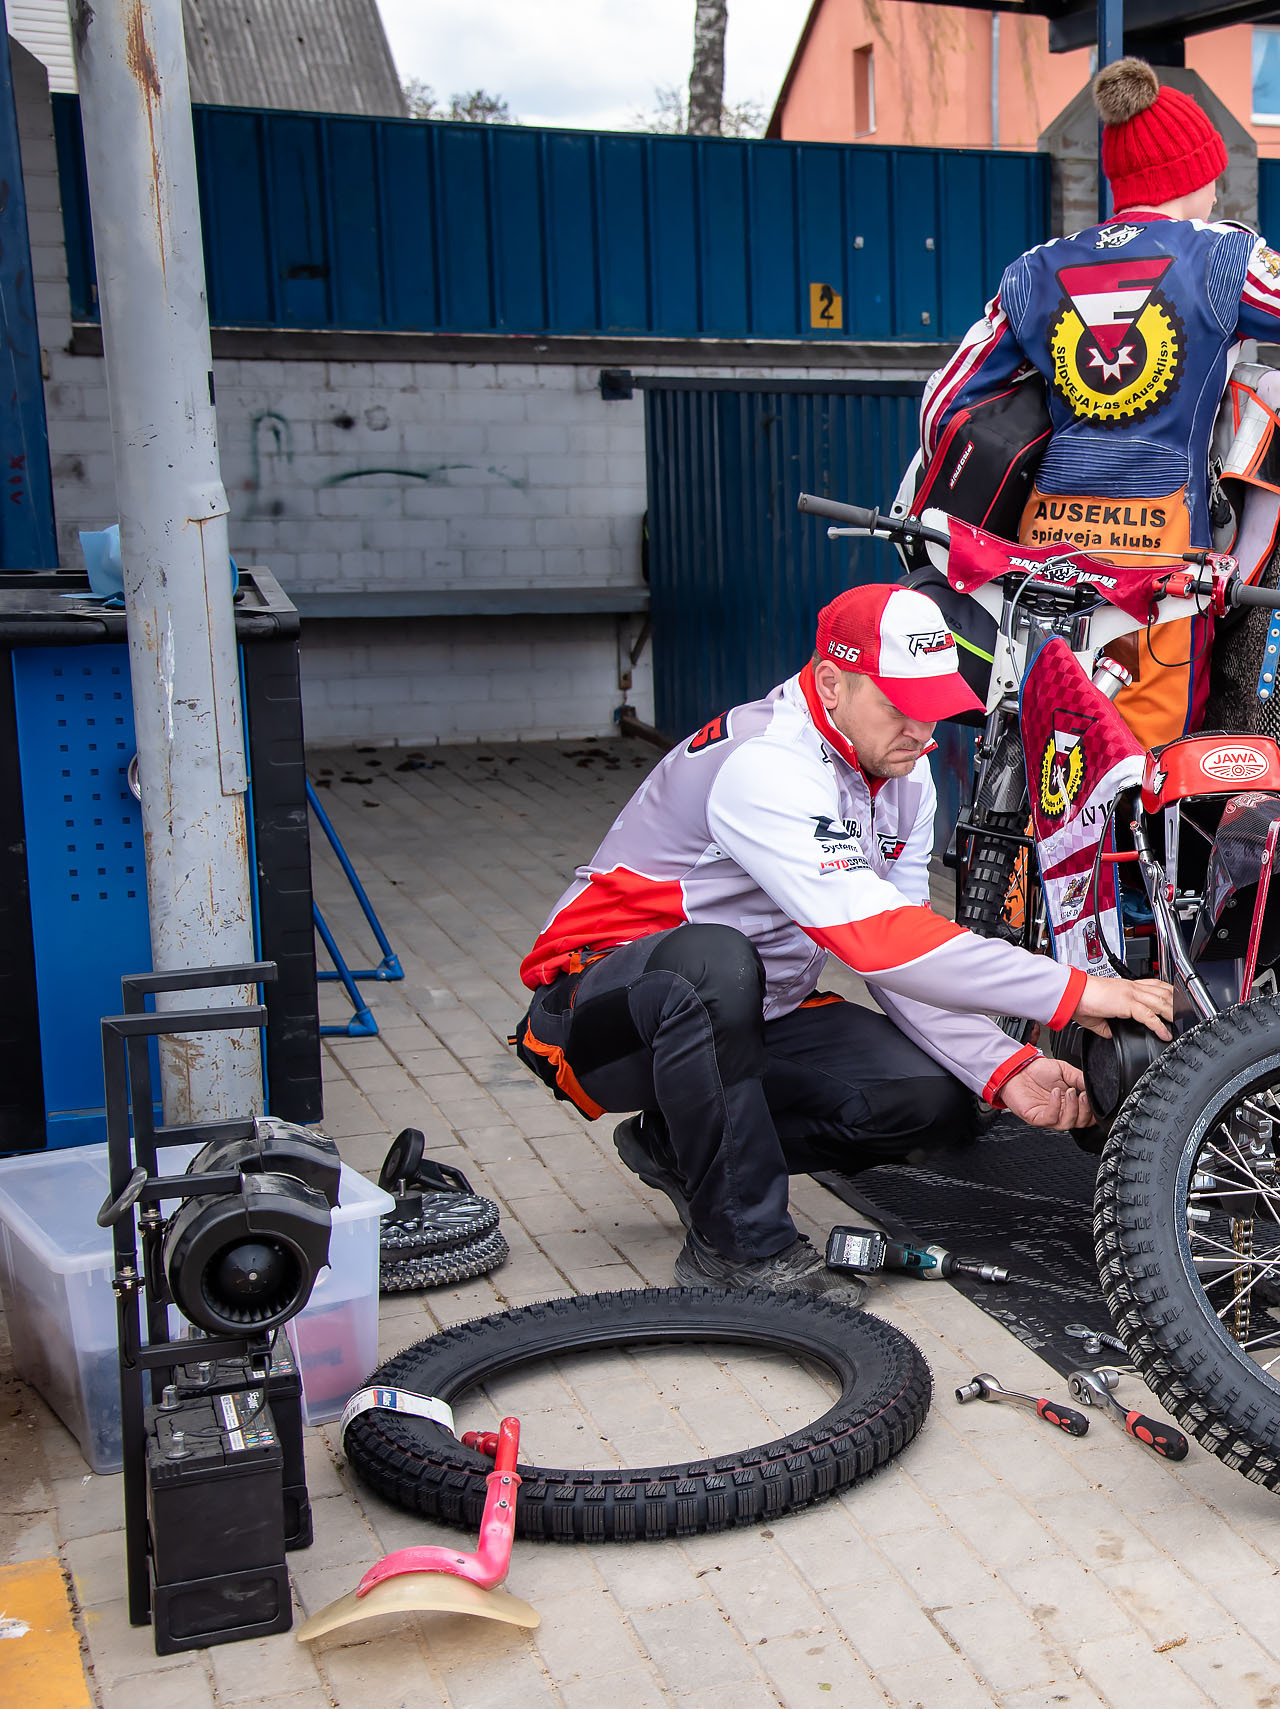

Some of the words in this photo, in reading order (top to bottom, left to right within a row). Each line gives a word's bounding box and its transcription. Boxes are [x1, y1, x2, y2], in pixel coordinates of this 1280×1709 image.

[819, 284, 834, 320] 2
[1124, 340, 1169, 406] «Auseklis»
[1034, 501, 1166, 528] AUSEKLIS
[1031, 527, 1102, 547] spīdveja
[1110, 532, 1161, 549] klubs
[1074, 568, 1119, 590] WEAR
[828, 640, 862, 663] #56
[1213, 753, 1258, 765] JAWA
[1081, 806, 1096, 828] LV
